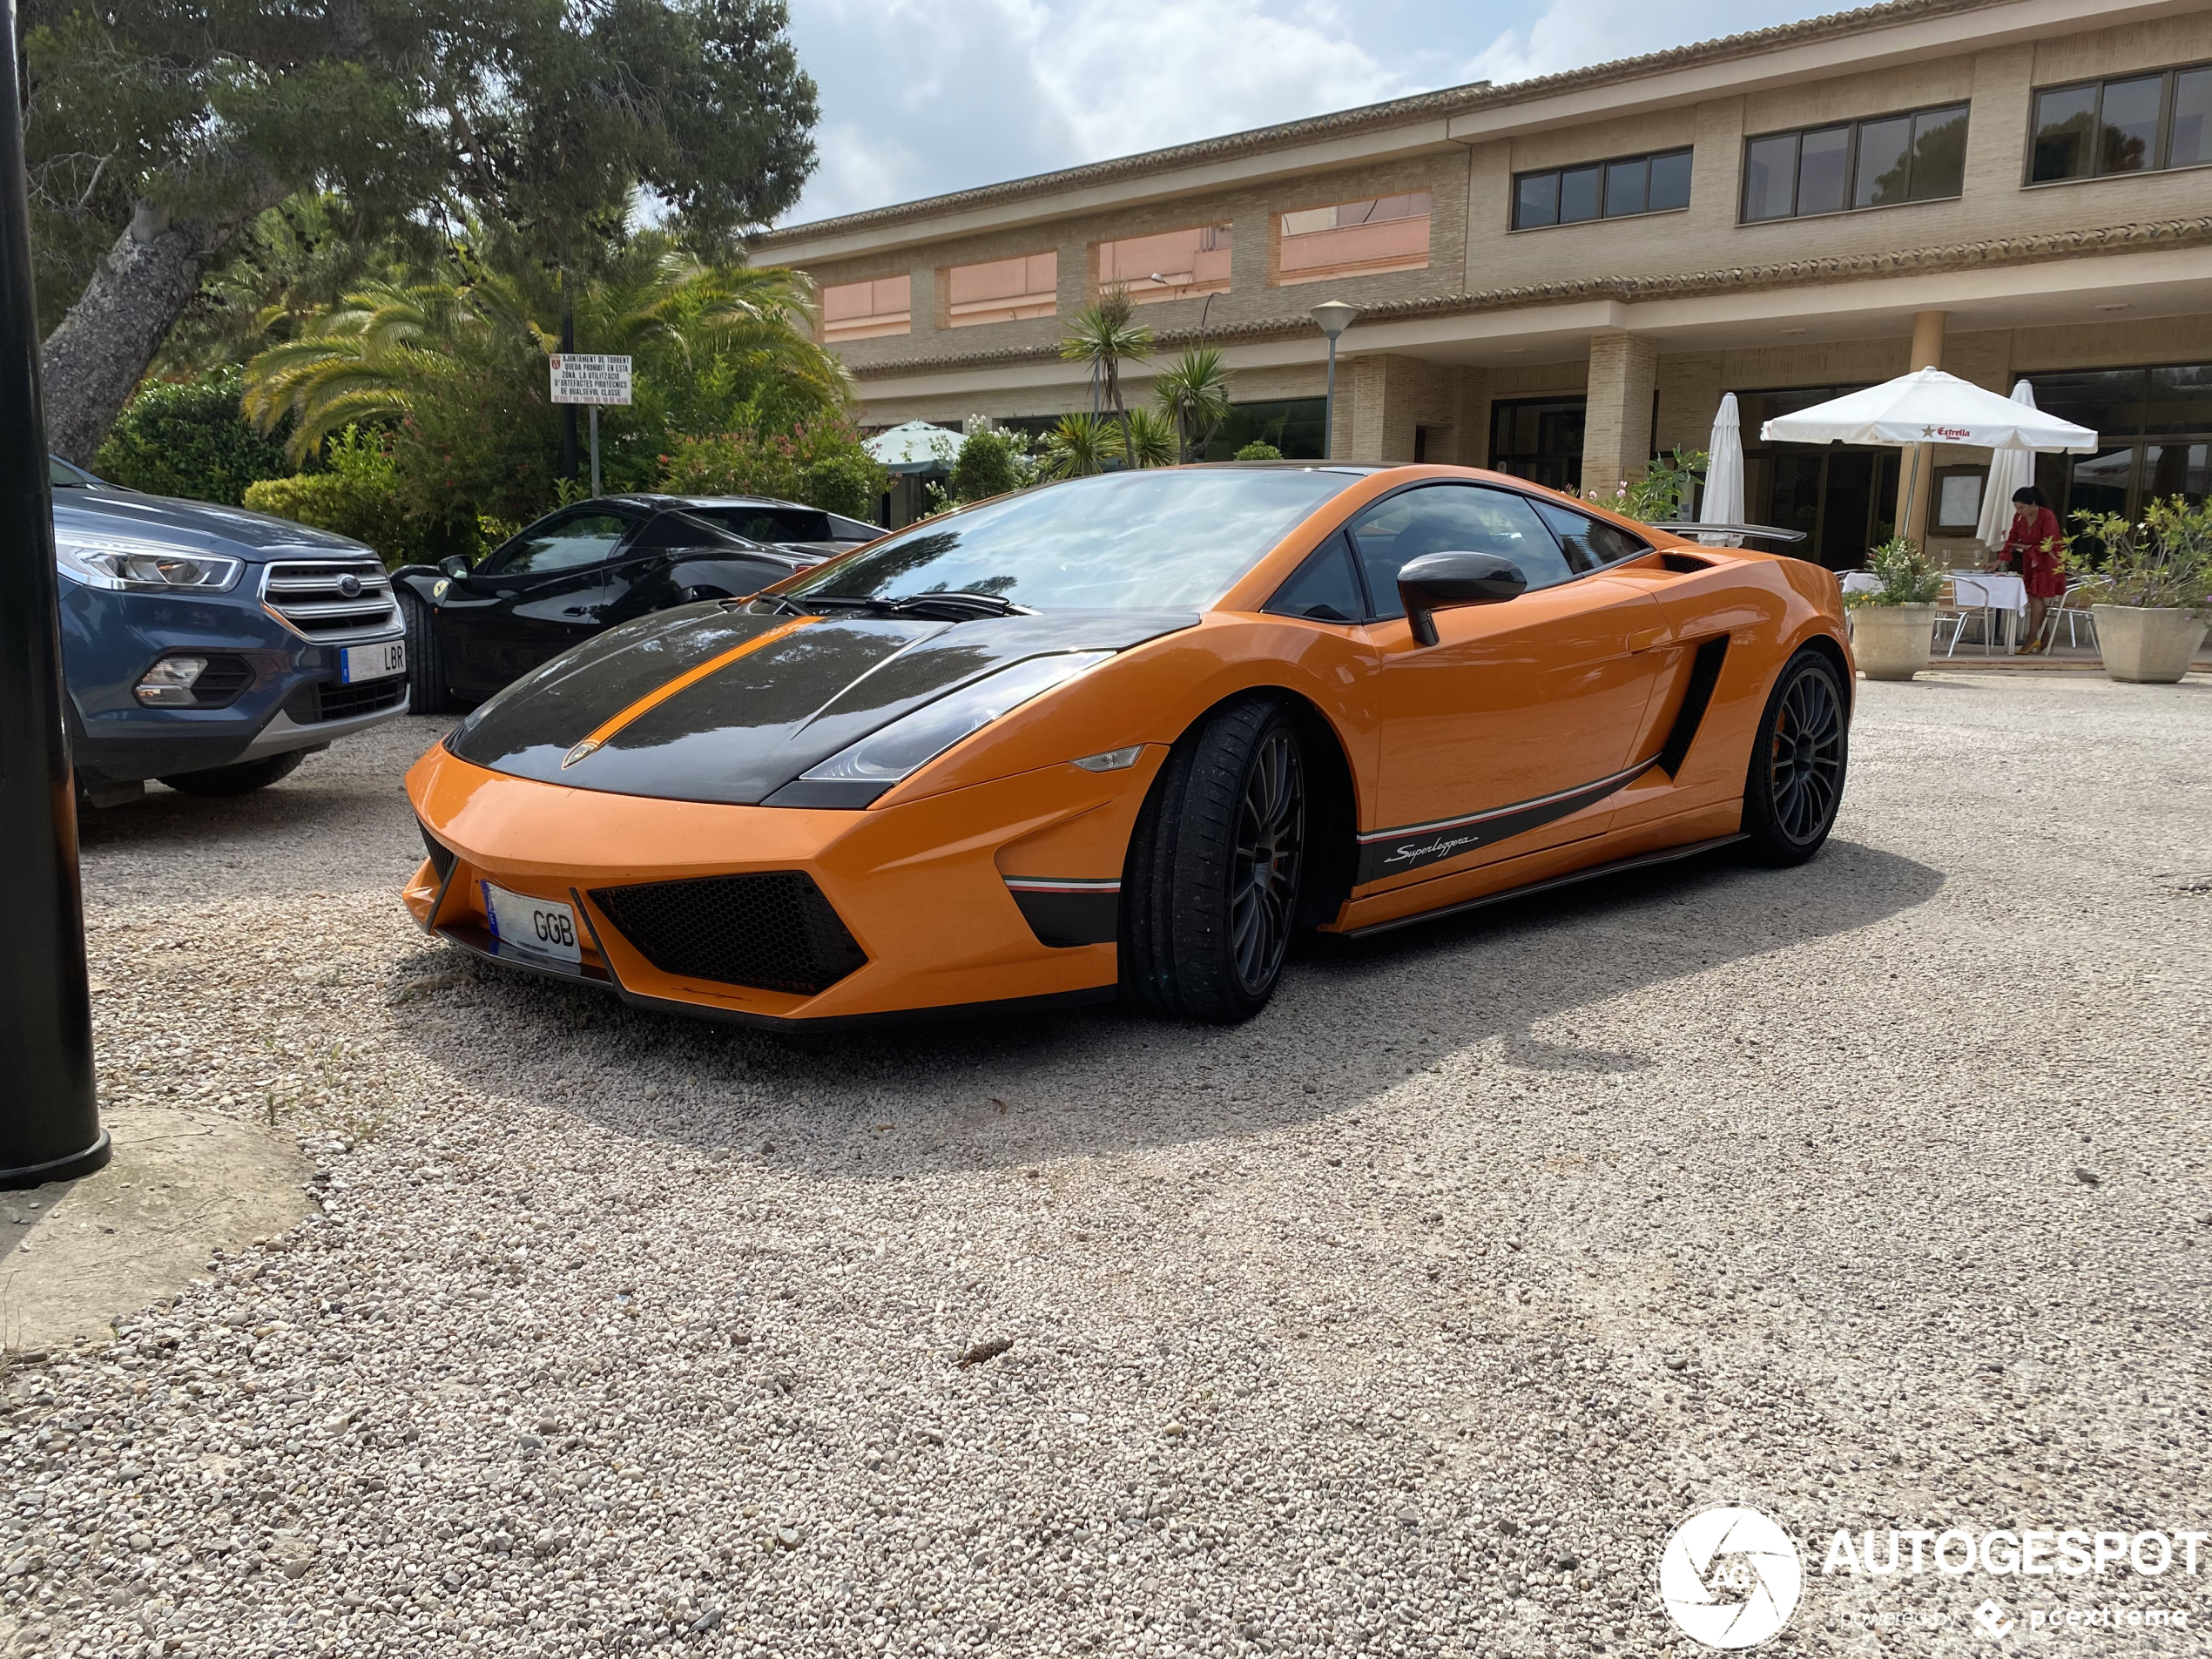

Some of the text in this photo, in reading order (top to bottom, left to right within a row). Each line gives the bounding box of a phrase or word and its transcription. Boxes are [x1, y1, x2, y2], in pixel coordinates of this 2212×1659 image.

[563, 354, 597, 363] AJUNTAMENT
[583, 363, 605, 372] PROHIBIT
[554, 379, 593, 388] D'ARTEFACTES
[569, 388, 599, 396] QUALSEVOL
[1938, 427, 1971, 437] Estrella
[384, 646, 403, 671] LBR
[1383, 836, 1480, 865] Superleggera
[533, 910, 575, 948] GGB
